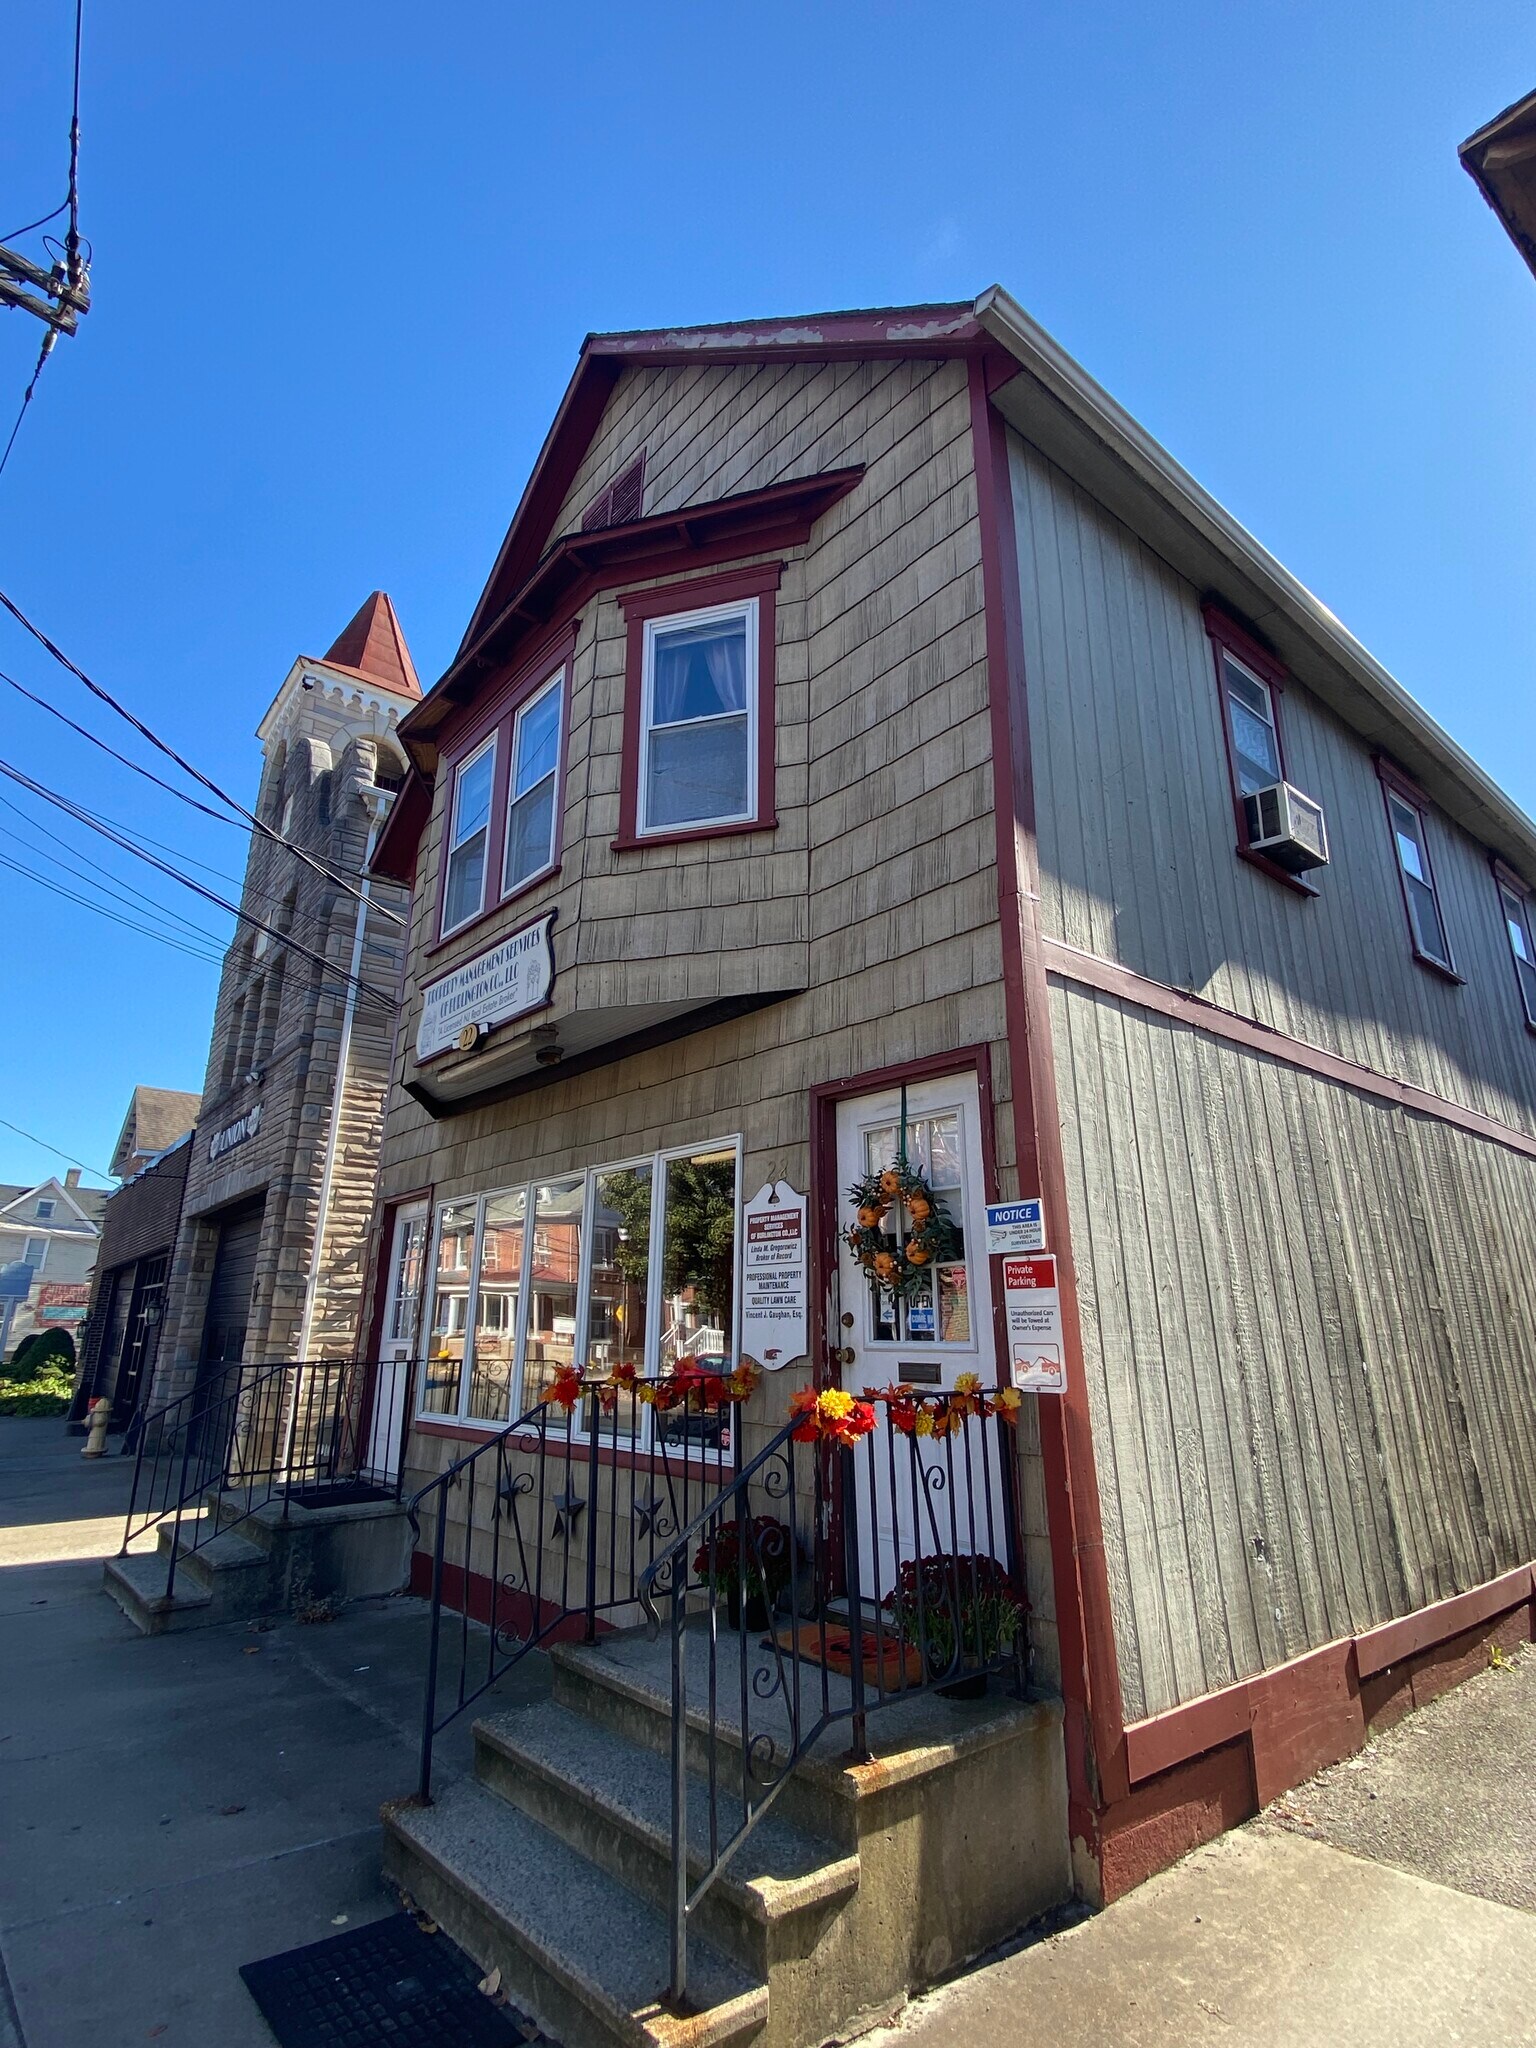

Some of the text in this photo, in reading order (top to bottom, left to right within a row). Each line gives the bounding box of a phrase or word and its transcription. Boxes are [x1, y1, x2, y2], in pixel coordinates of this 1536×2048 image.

[460, 947, 505, 986] MANAGEMENT
[506, 927, 540, 962] SERVICES
[505, 962, 519, 983] LLC
[462, 1027, 472, 1047] 22
[221, 1117, 248, 1151] UNION
[995, 1207, 1032, 1222] NOTICE
[751, 1245, 762, 1253] Linda
[1007, 1265, 1033, 1274] Private
[747, 1271, 802, 1281] PROFESSIONAL PROPERTY
[1008, 1276, 1036, 1287] Parking
[759, 1281, 789, 1289] MAINTENANCE
[752, 1297, 769, 1305] QUALITY
[771, 1296, 783, 1304] LAWN
